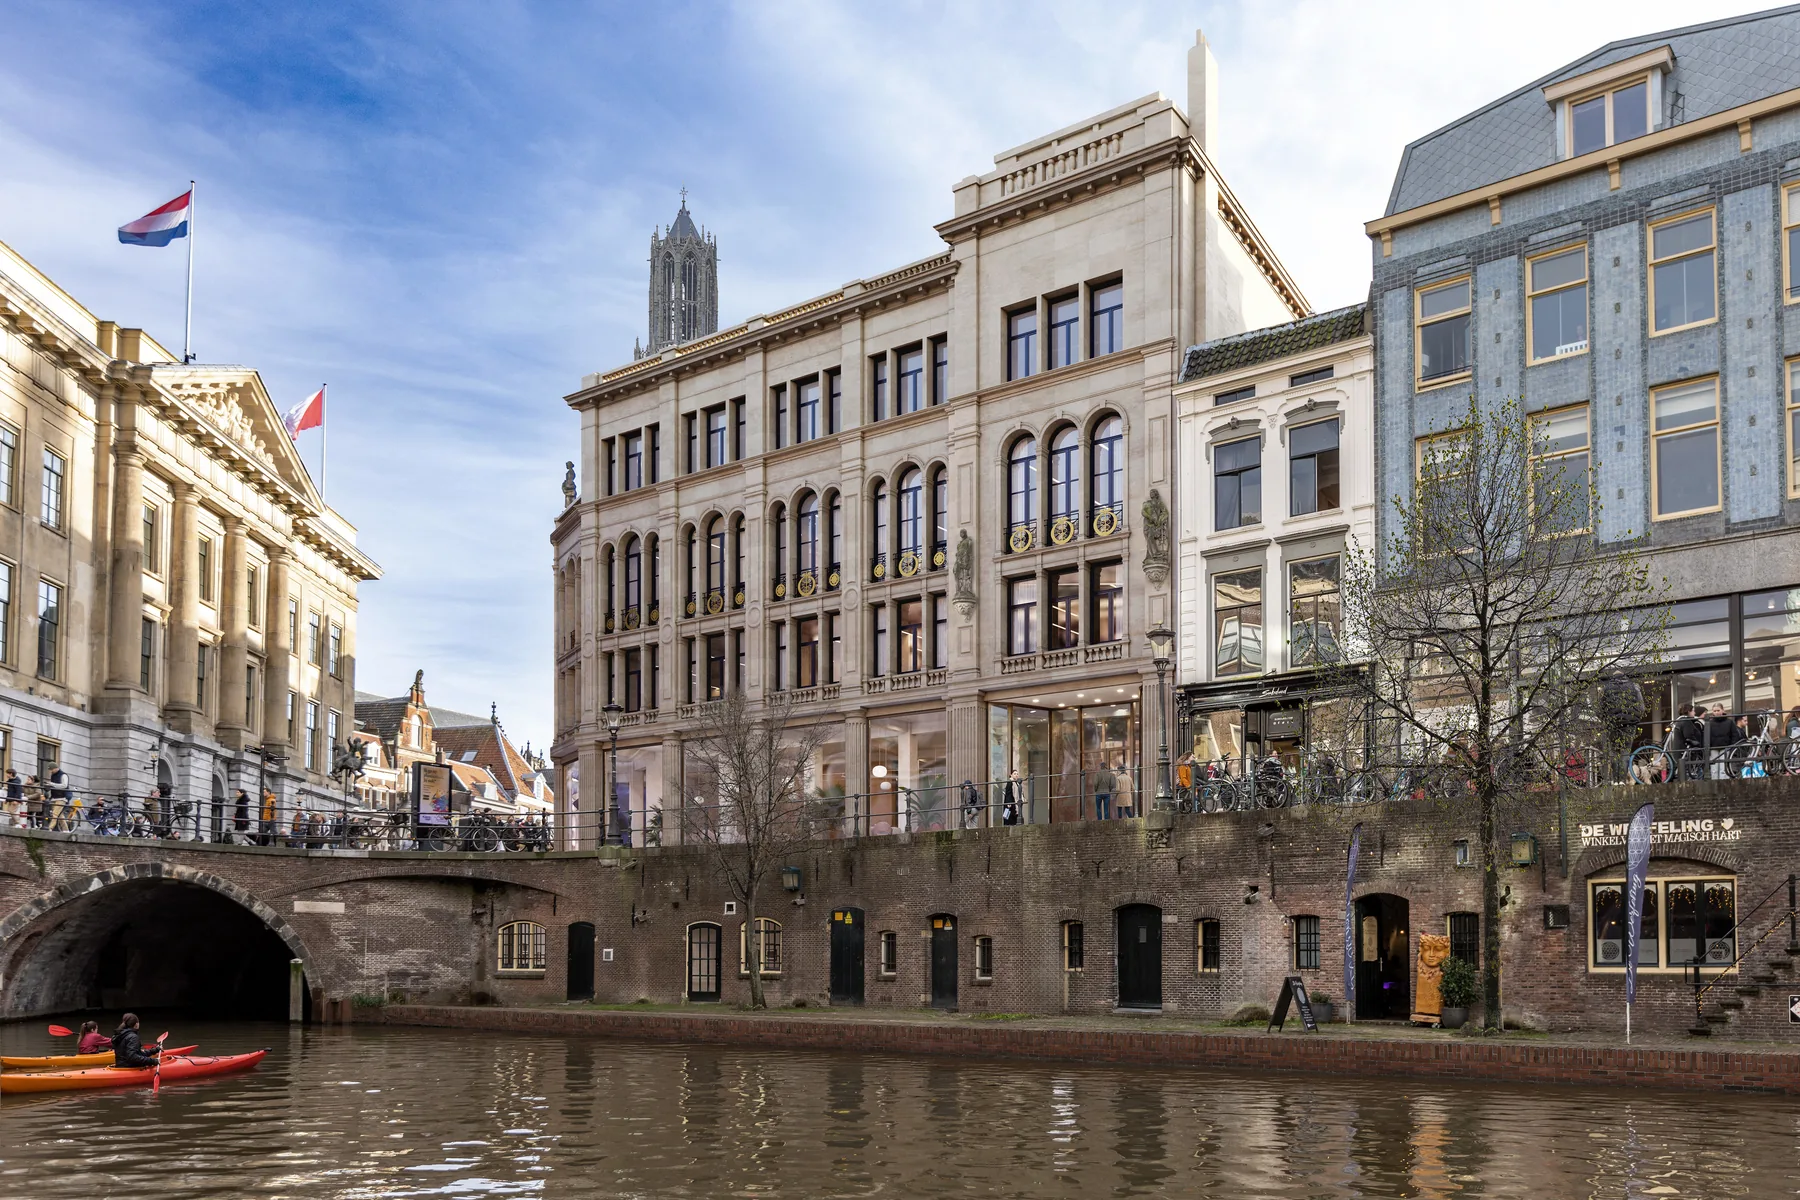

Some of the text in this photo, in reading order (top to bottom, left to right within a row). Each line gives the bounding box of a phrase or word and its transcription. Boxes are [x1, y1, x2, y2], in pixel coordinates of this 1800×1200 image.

[1581, 824, 1604, 838] DE
[1664, 831, 1710, 844] MAGISCH
[1711, 829, 1742, 841] HART
